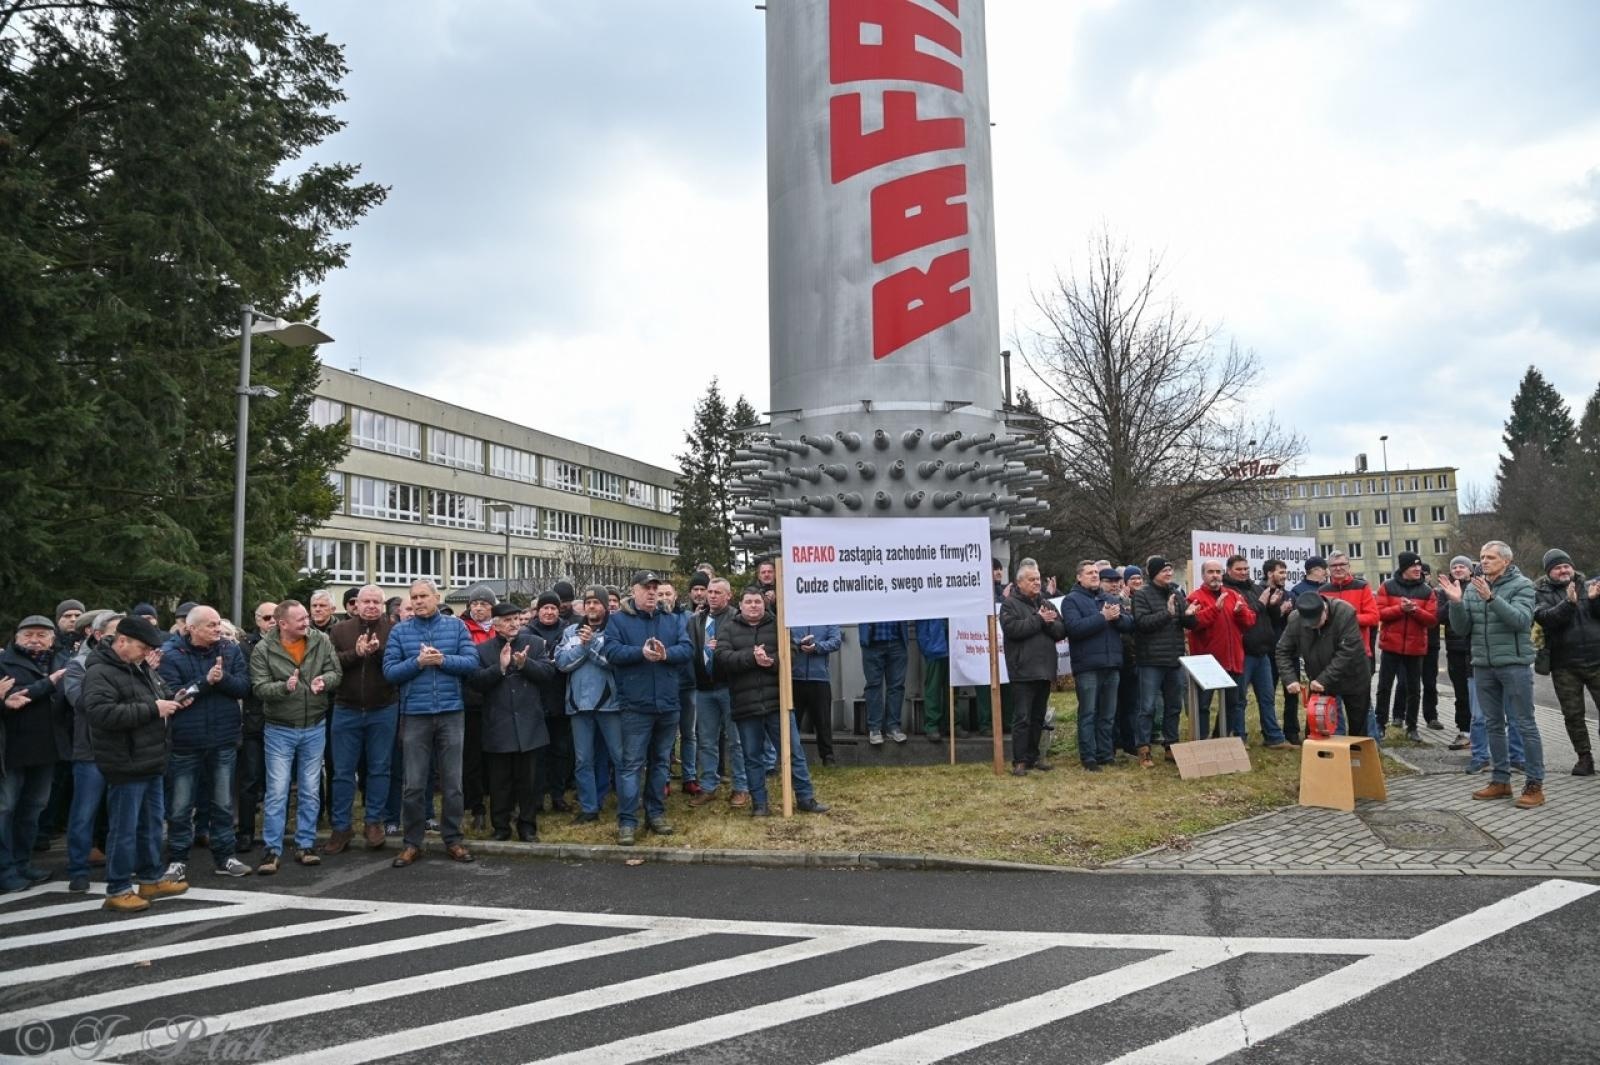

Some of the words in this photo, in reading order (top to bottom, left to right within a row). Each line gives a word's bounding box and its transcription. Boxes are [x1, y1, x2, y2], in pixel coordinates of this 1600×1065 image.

[792, 545, 835, 563] RAFAKO
[839, 545, 883, 566] zastąpią
[886, 545, 937, 561] zachodnie
[940, 543, 982, 563] firmy(?!)
[1199, 542, 1235, 558] RAFAKO
[1250, 545, 1264, 559] nie
[796, 576, 828, 594] Cudze
[833, 575, 887, 593] chwalicie,
[891, 576, 923, 592] swego
[927, 574, 942, 589] nie
[946, 571, 981, 588] znacie!
